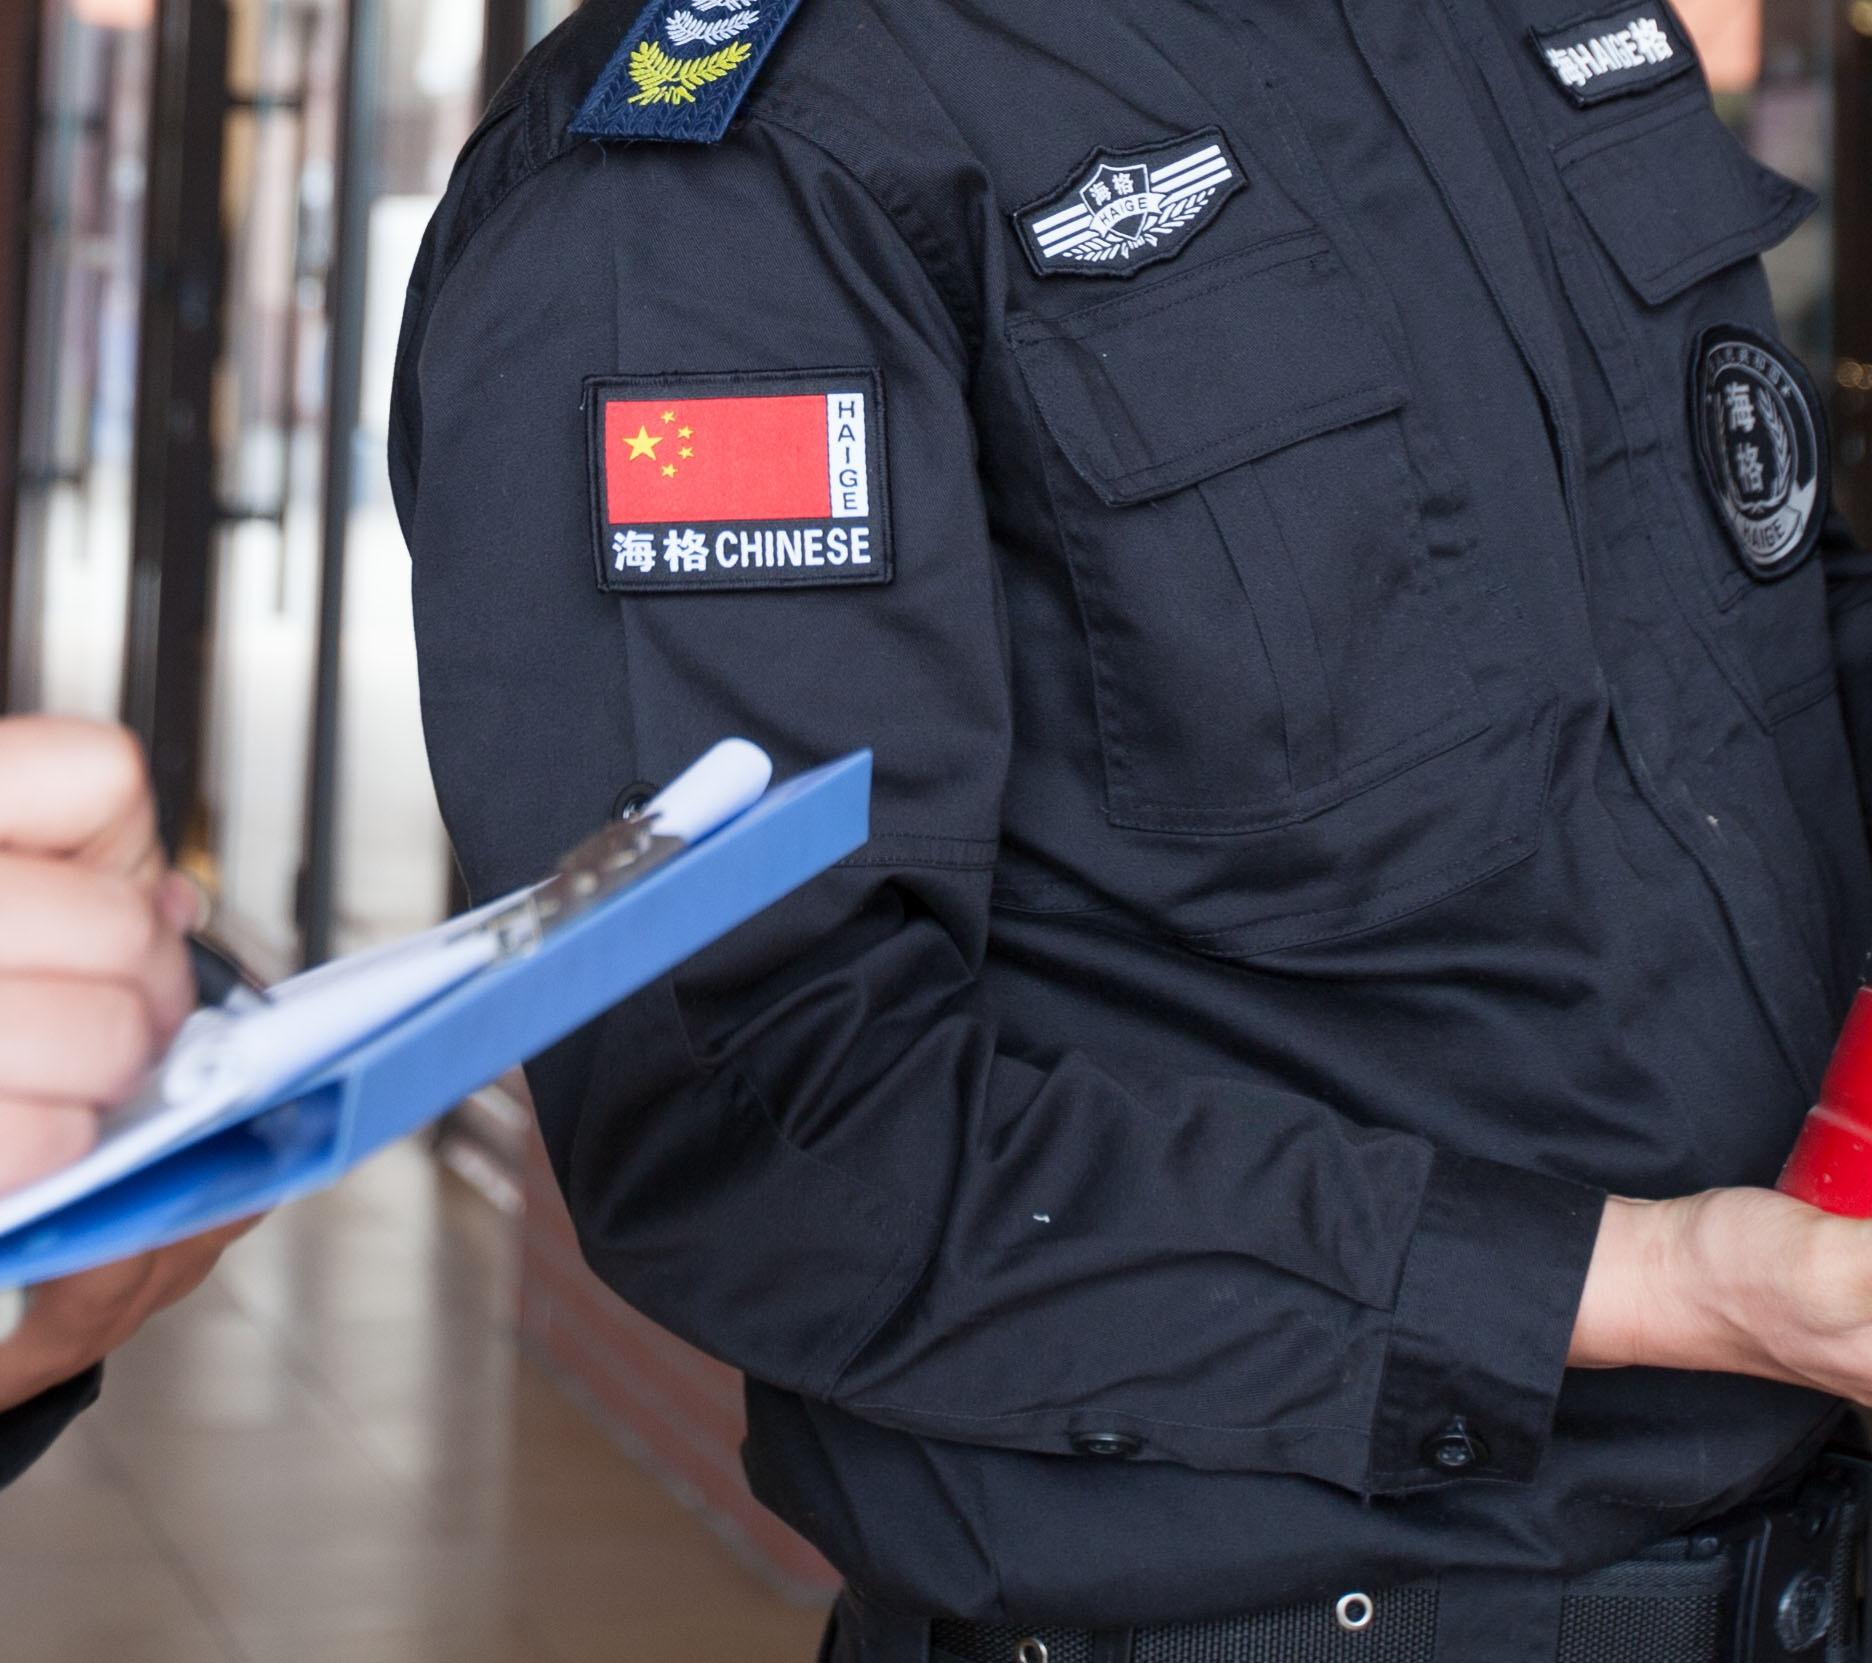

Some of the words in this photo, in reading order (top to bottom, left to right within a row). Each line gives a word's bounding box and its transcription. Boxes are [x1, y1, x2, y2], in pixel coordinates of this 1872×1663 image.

[1089, 172, 1134, 206] 海格
[1100, 197, 1147, 226] HAIGE
[837, 400, 859, 510] HAIGE
[715, 527, 871, 568] CHINESE
[1742, 519, 1784, 549] HAIGE
